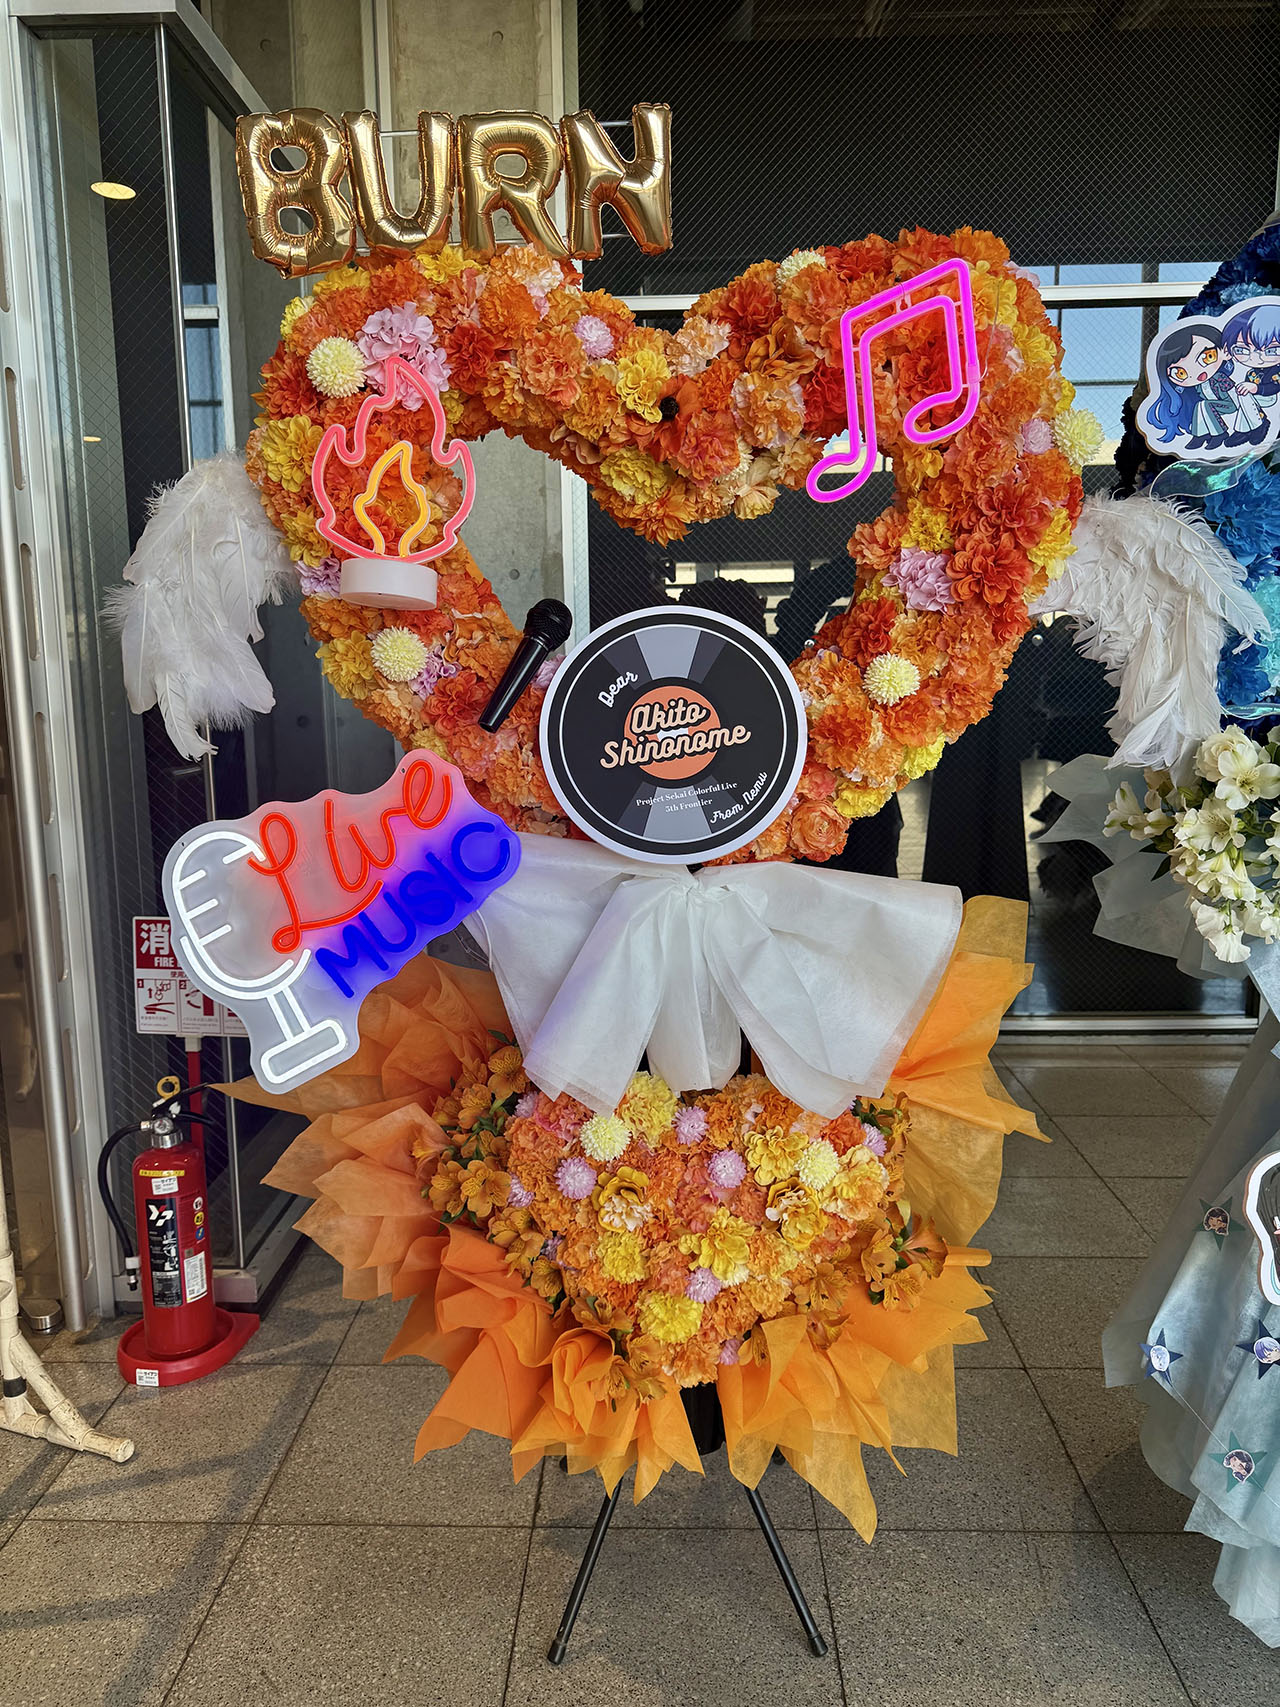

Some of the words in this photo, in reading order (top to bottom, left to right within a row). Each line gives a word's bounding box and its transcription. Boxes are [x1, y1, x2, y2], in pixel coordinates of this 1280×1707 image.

[235, 102, 673, 279] BURN
[598, 671, 638, 708] Dear
[631, 698, 707, 734] Akito
[600, 725, 752, 769] Shinonome
[636, 796, 664, 806] Project
[665, 791, 687, 801] Sekai
[688, 783, 720, 796] Colorful
[721, 781, 738, 790] Live
[665, 804, 679, 813] 5th
[680, 798, 713, 810] Frontier
[710, 803, 743, 824] From
[742, 771, 768, 805] Nemu
[247, 759, 453, 953] Live
[315, 821, 511, 999] MUSIC
[154, 956, 175, 967] FIRE
